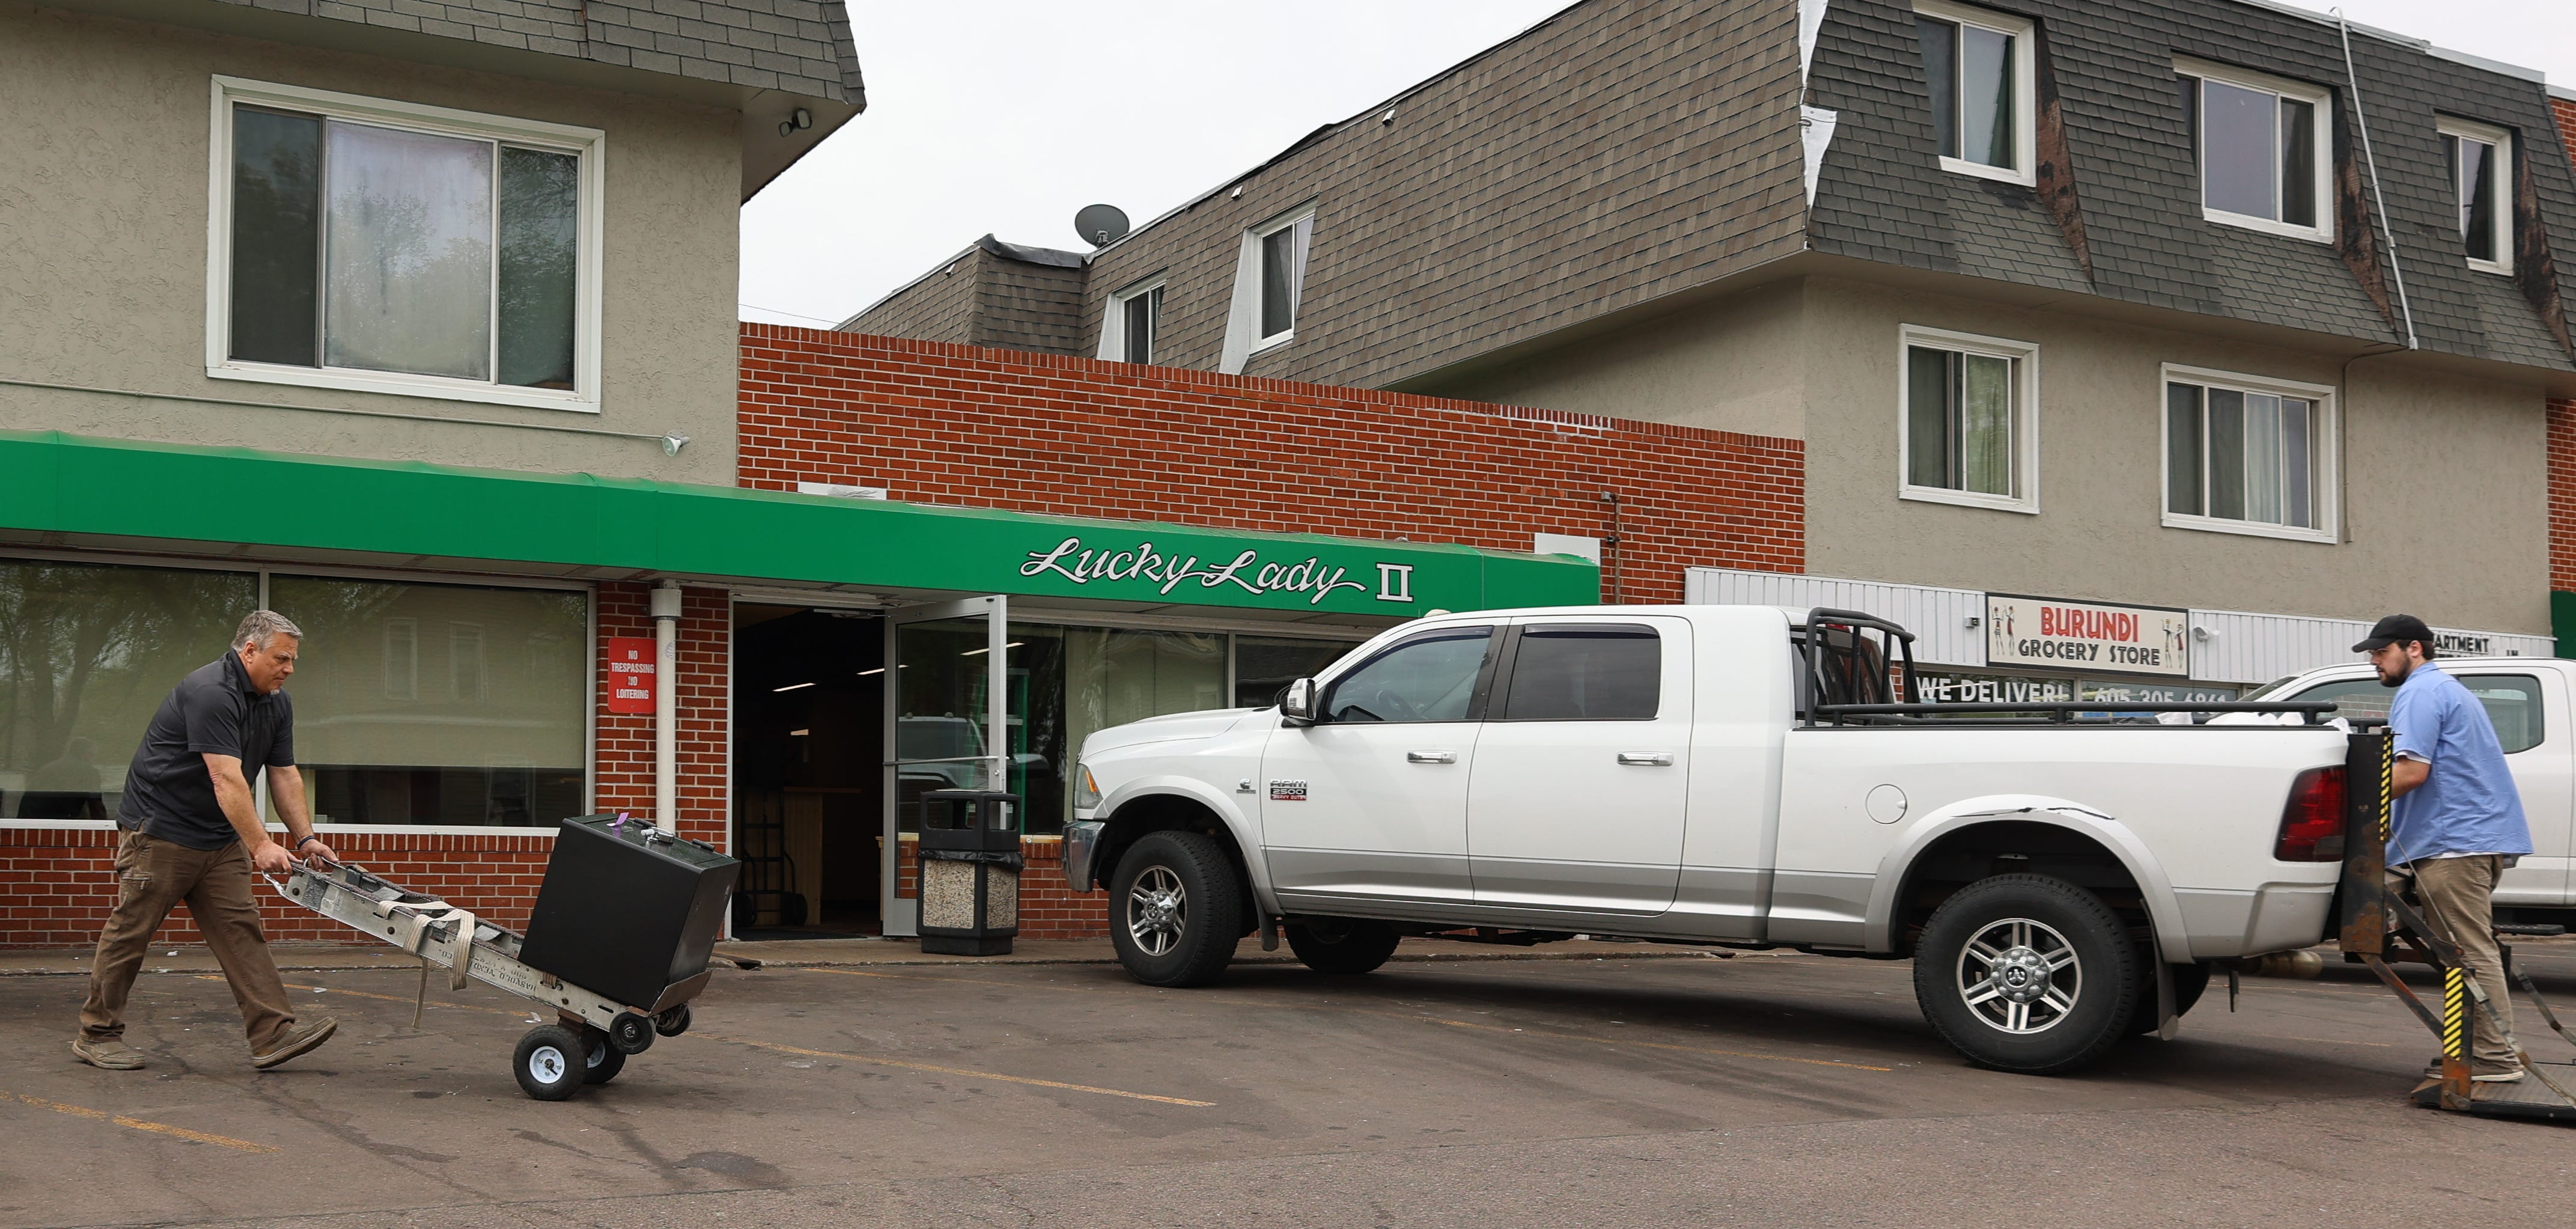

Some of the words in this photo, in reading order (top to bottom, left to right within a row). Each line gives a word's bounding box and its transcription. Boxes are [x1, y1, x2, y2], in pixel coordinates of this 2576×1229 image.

[1020, 537, 1204, 595] Lucky
[1202, 549, 1366, 605] Lady
[1376, 562, 1413, 602] II
[2041, 606, 2139, 642] BURUNDI
[2435, 634, 2489, 653] ARTMENT
[628, 650, 638, 660] NO
[2018, 639, 2099, 661] GROCERY
[2110, 645, 2160, 665] STORE
[611, 662, 654, 674] TRESPASSING
[628, 676, 638, 686] NO
[616, 689, 649, 700] LOITERING
[1916, 677, 1952, 701] WE
[1961, 679, 2063, 703] DELIVER!
[1270, 779, 1307, 787] RAM
[469, 962, 495, 977] VENDI
